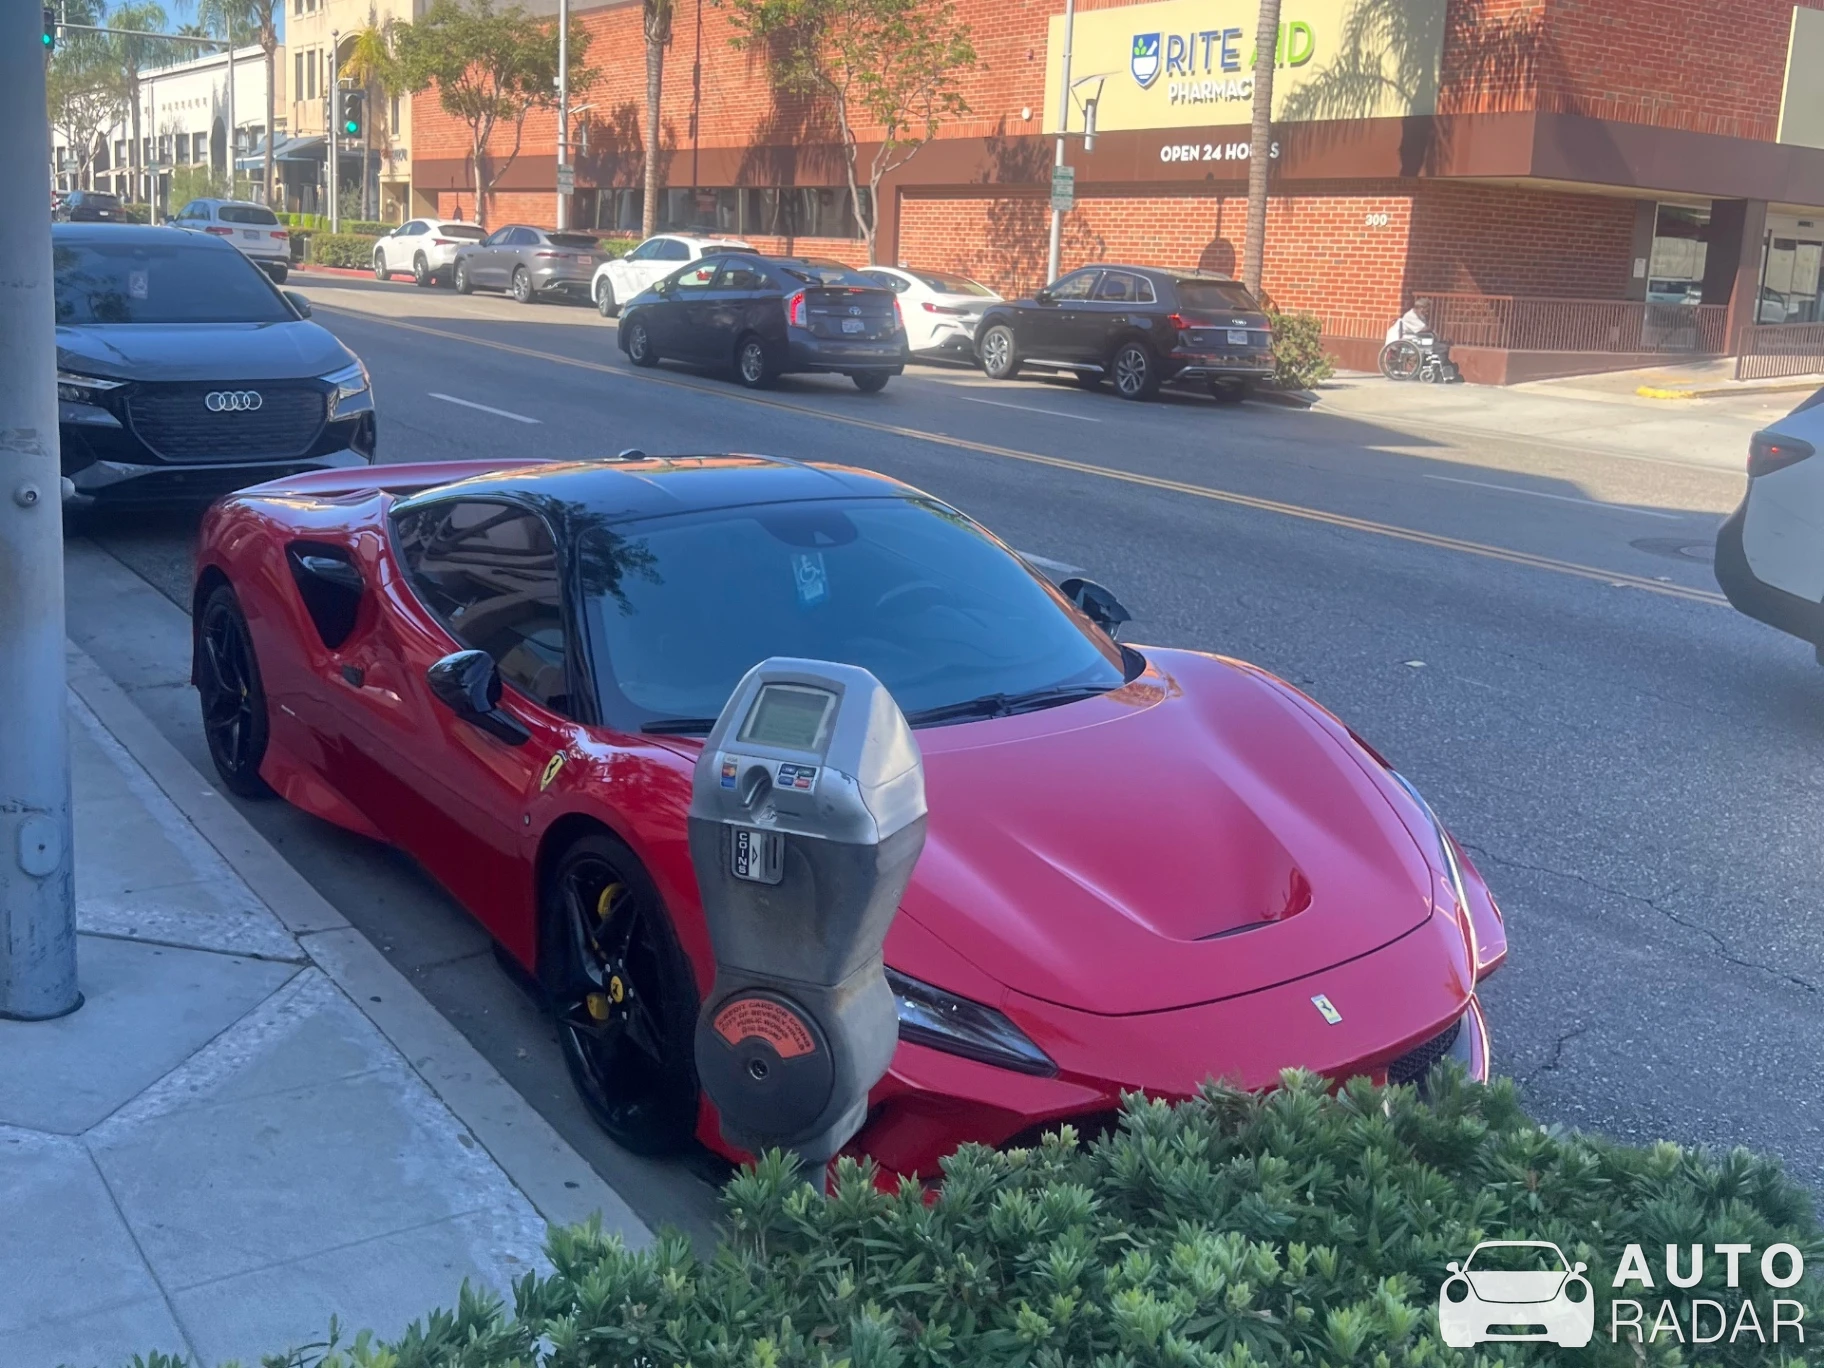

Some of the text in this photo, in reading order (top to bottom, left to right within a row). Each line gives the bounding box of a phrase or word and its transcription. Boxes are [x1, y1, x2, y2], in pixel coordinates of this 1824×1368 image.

[1166, 27, 1241, 73] RITE
[1160, 142, 1280, 162] OPEN 24 HOS
[1365, 213, 1388, 227] 300
[737, 832, 748, 874] COINS
[749, 1002, 774, 1011] CARD
